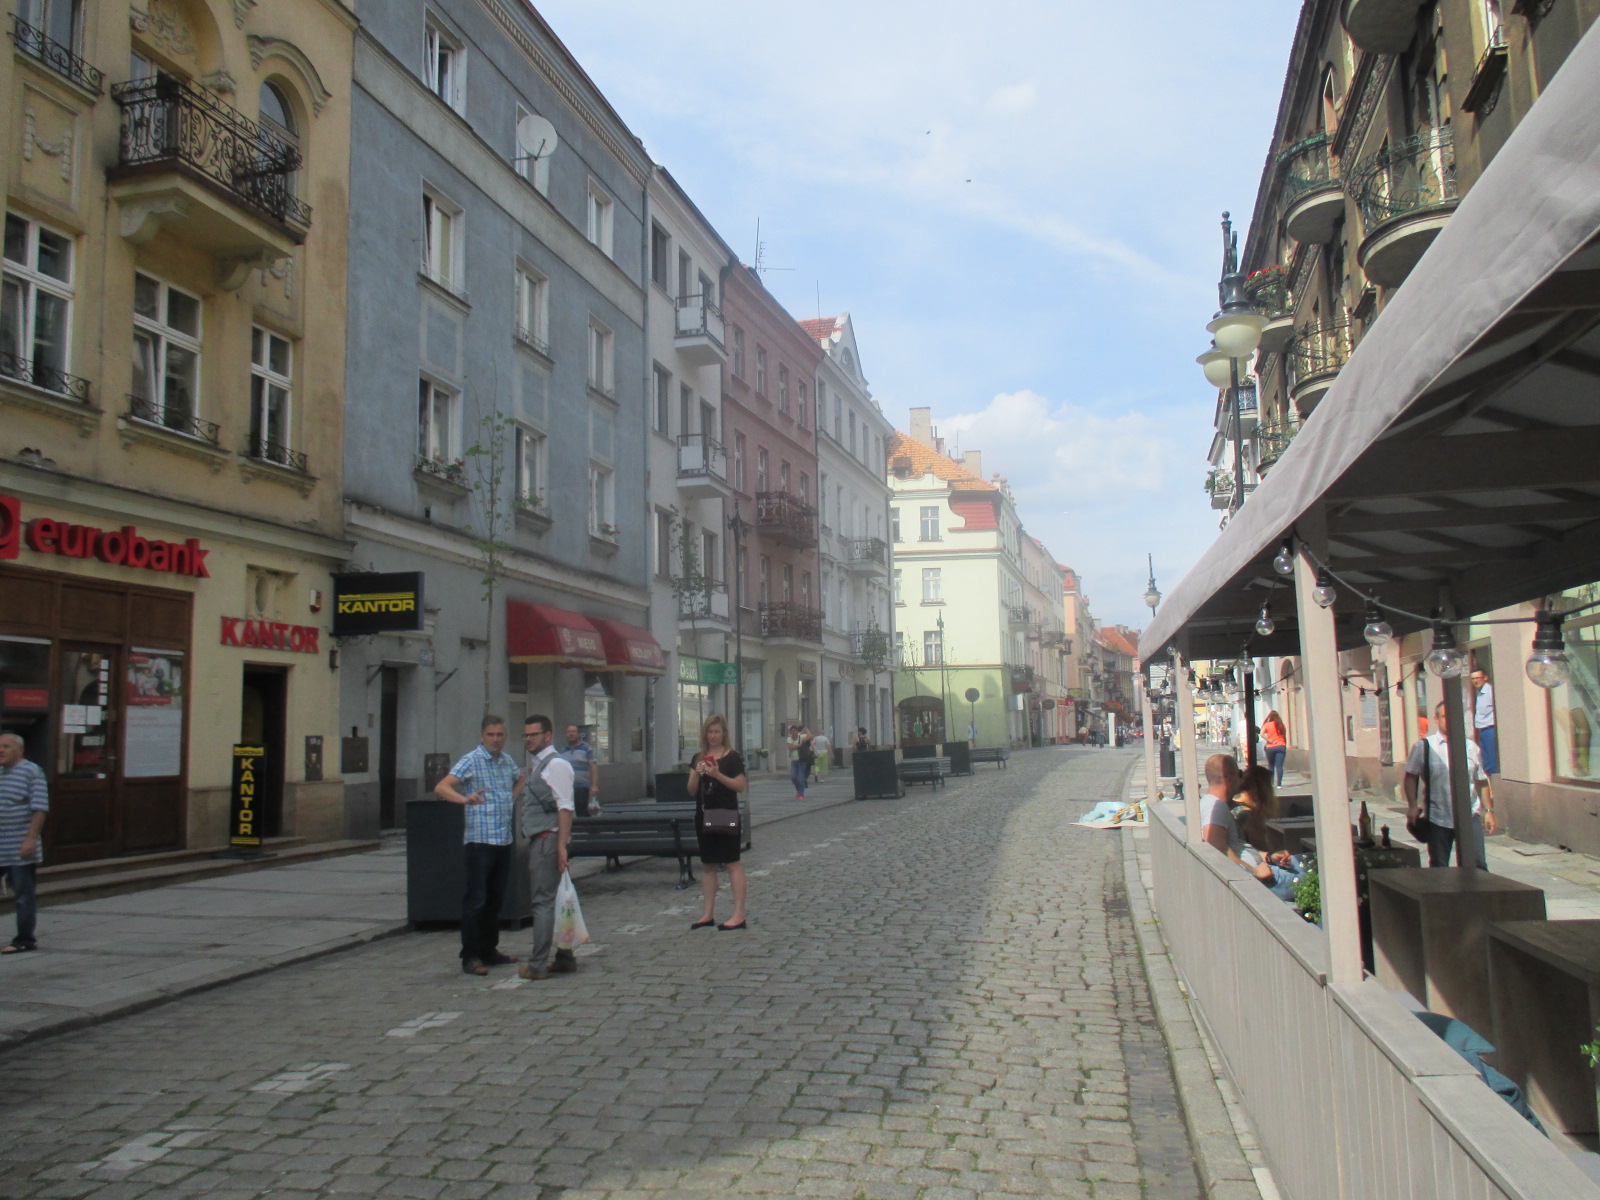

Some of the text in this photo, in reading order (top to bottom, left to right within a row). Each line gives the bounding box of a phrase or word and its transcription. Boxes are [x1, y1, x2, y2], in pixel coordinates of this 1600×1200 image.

[27, 518, 211, 578] eurobank
[339, 599, 414, 613] KANTOR
[221, 616, 319, 654] KANTOR
[240, 758, 254, 835] KANTOR
